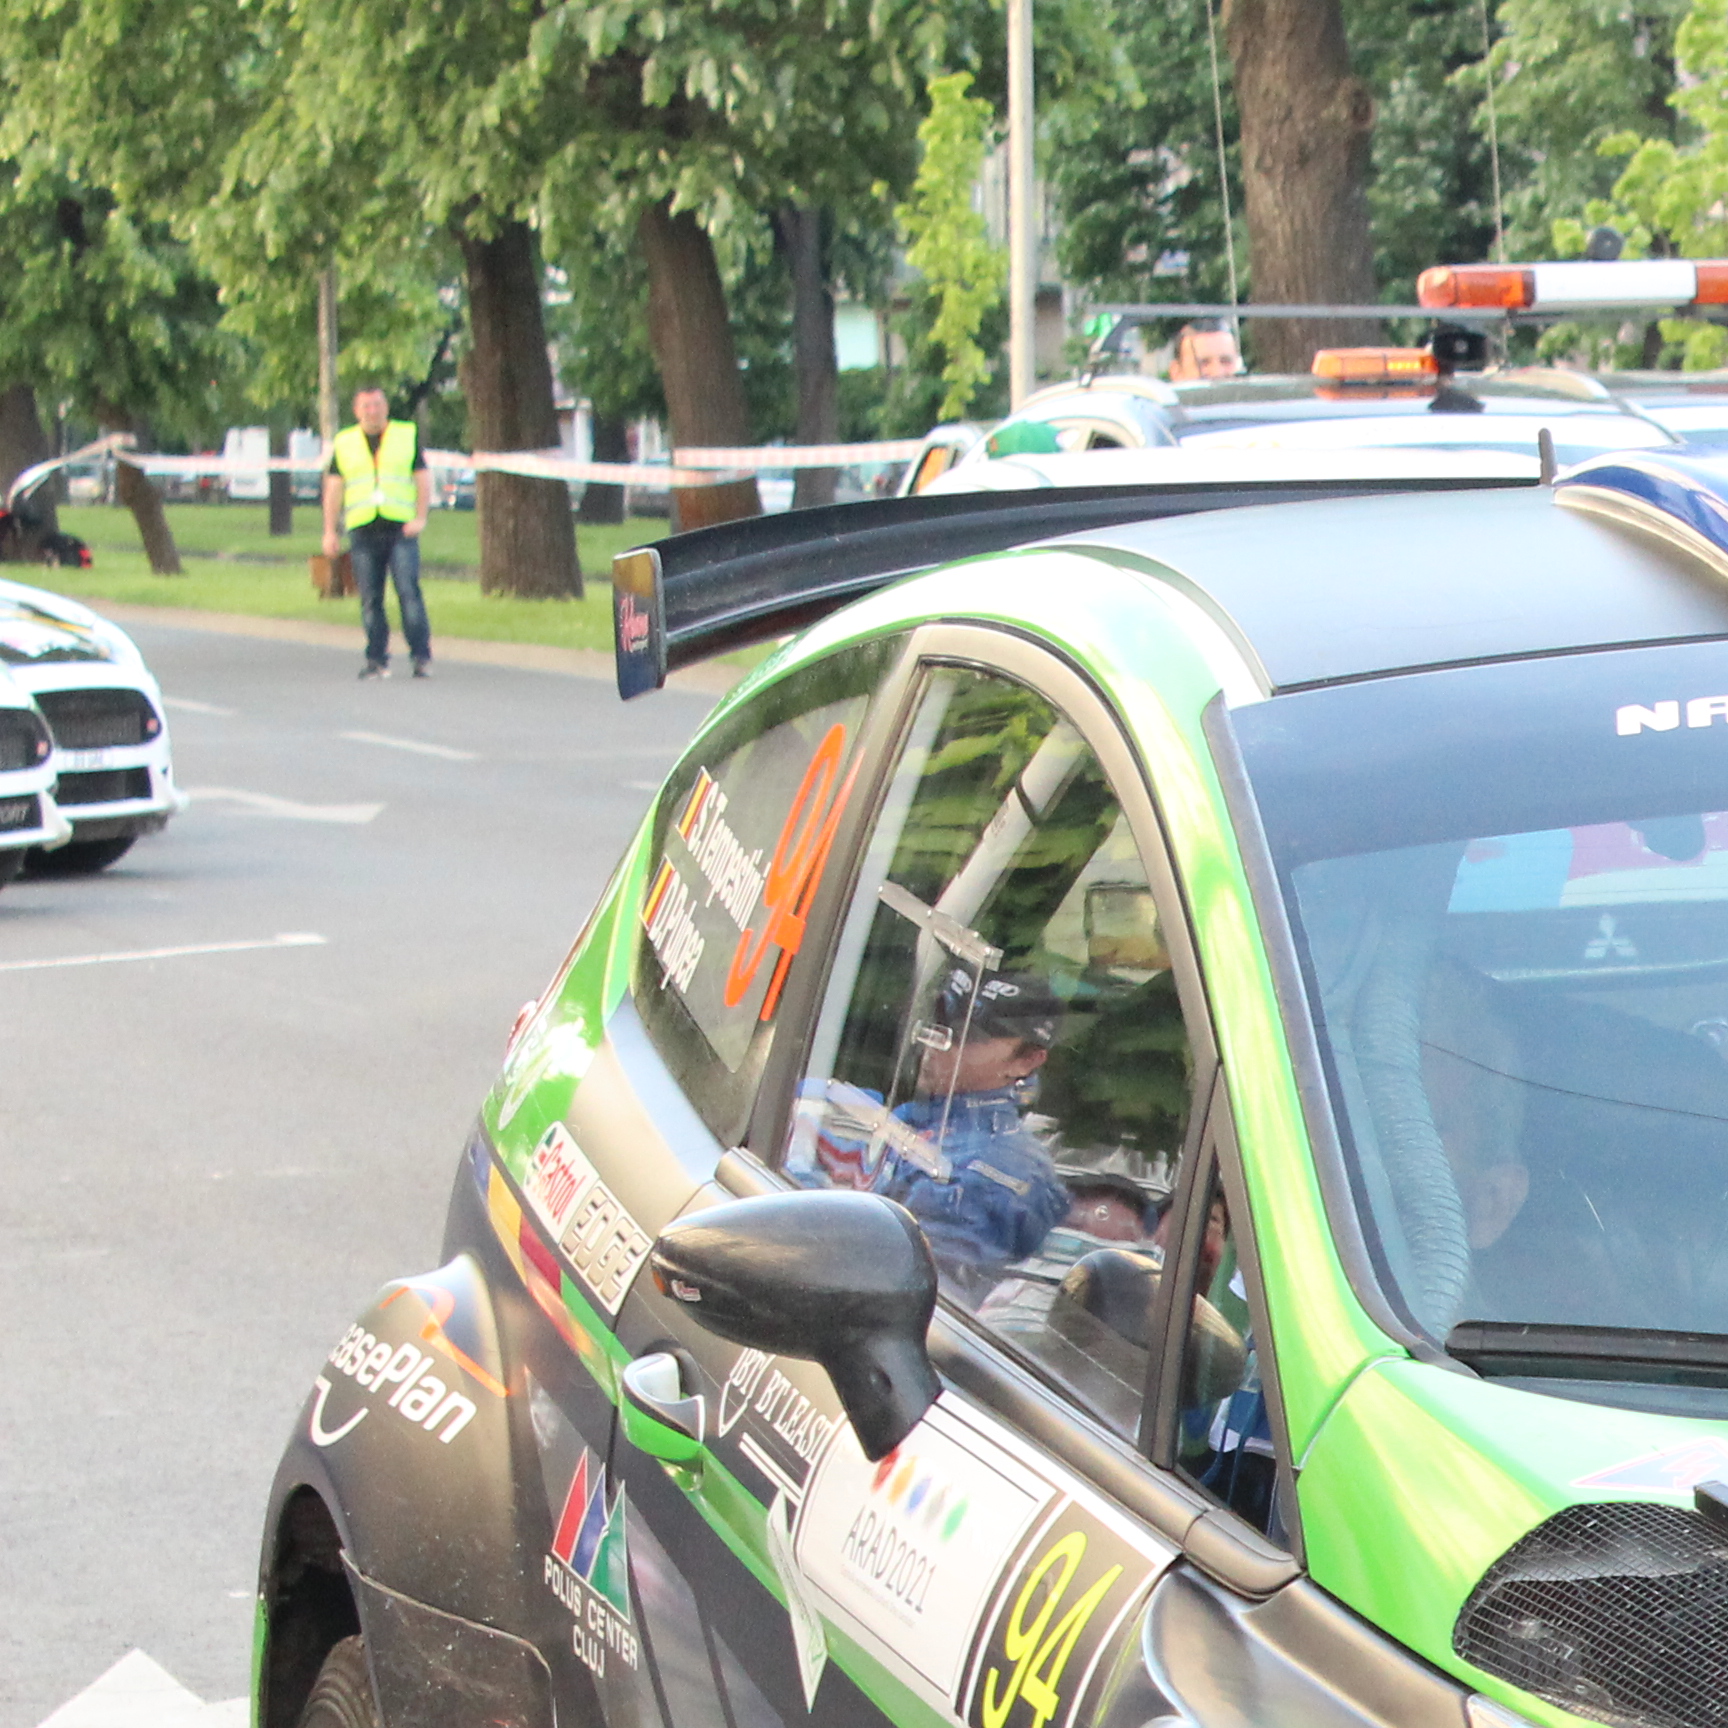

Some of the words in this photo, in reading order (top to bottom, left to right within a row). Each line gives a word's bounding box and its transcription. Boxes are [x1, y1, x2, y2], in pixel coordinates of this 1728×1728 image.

[723, 723, 867, 1021] 94
[534, 1140, 587, 1226] Castrol
[561, 1184, 653, 1304] EDGE
[330, 1322, 478, 1444] easePlan
[545, 1553, 585, 1614] POLUS
[587, 1602, 639, 1671] CENTER
[572, 1627, 605, 1682] CLUJ
